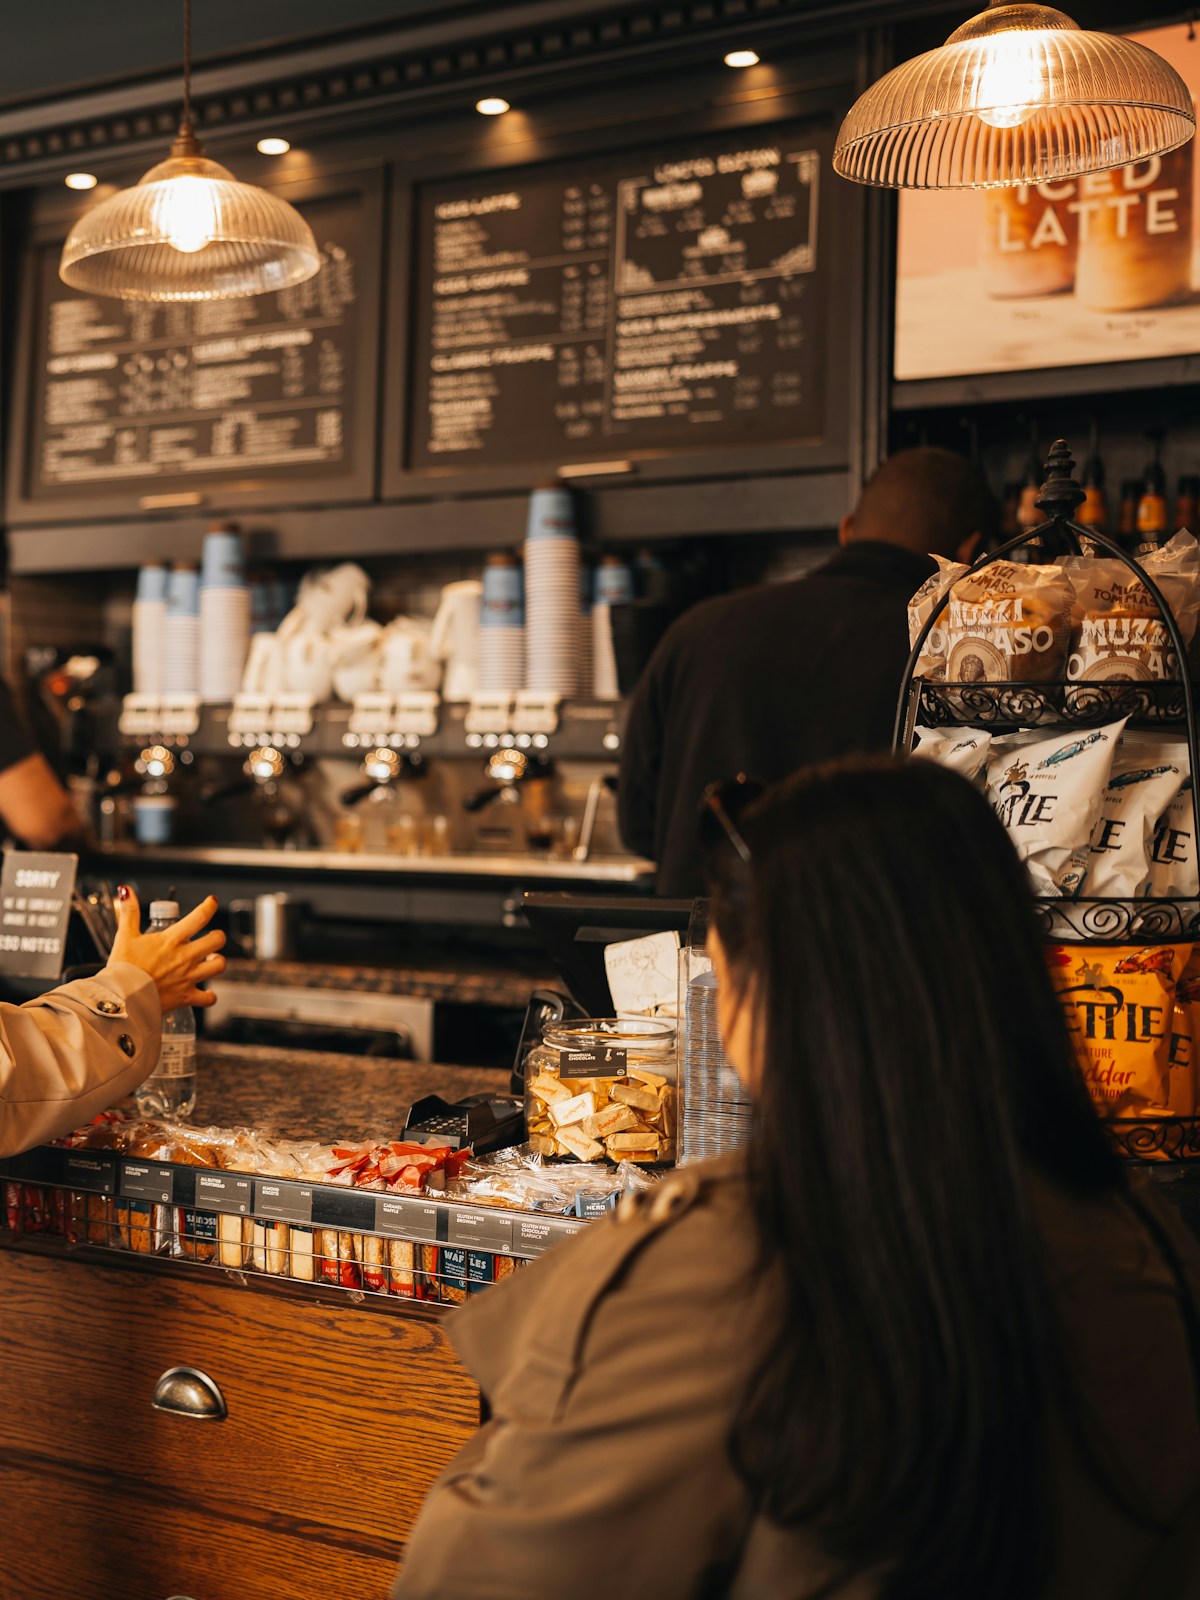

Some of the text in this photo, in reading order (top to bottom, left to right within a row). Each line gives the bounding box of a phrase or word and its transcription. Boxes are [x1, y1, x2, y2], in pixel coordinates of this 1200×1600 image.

[999, 188, 1180, 252] LATTE
[1093, 588, 1158, 608] TOMMAS
[1110, 582, 1150, 596] MUZZ
[1078, 617, 1167, 649] MUZZ
[15, 869, 61, 889] SORRY
[20, 936, 61, 954] NOTES
[1062, 1001, 1164, 1043] ETTLE
[1084, 1060, 1136, 1086] ddar
[383, 1203, 403, 1211] CARAMEL
[186, 1214, 216, 1226] ISCUITS
[521, 1227, 548, 1236] CHOCOLATE
[444, 1250, 487, 1270] WAFLES
[325, 1266, 344, 1276] ALMOD
